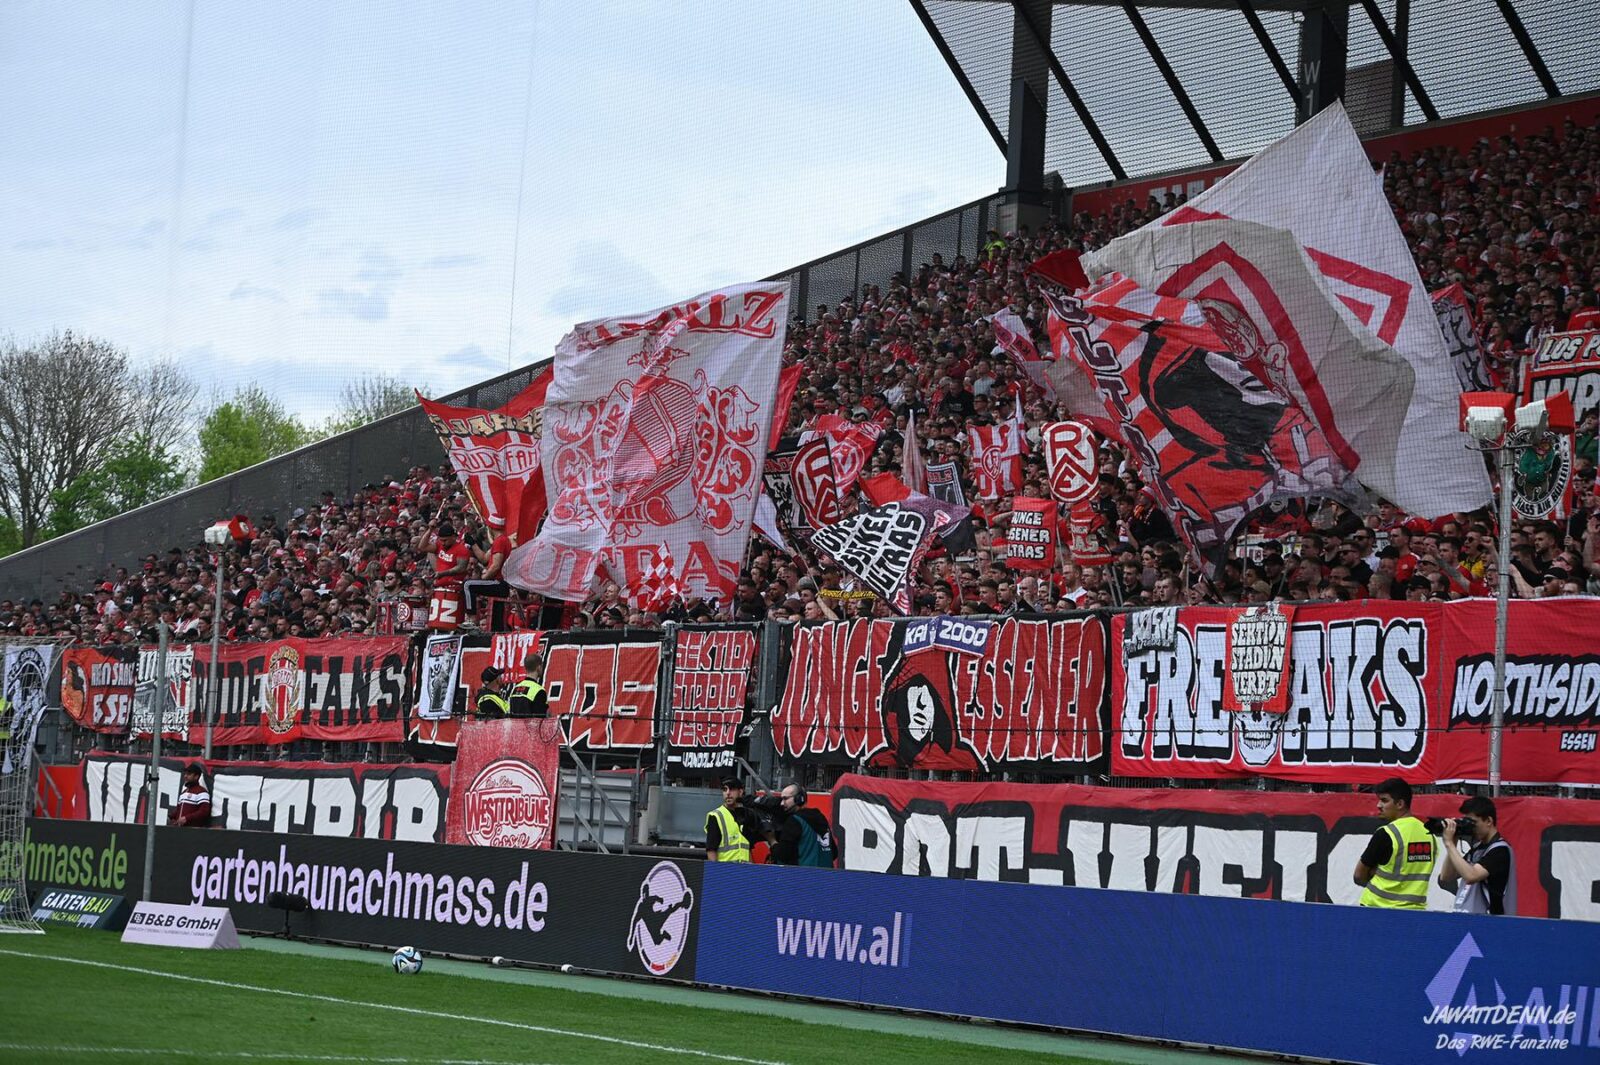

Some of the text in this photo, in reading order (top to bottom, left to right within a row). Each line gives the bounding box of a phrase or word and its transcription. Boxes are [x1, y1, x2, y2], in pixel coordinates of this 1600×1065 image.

[1304, 60, 1320, 85] W
[1306, 89, 1314, 116] 1
[1539, 336, 1583, 362] LOS
[1010, 511, 1043, 526] UNGE
[1007, 543, 1045, 560] LTRAS
[938, 619, 989, 647] 2000
[674, 630, 756, 671] SEKTION
[193, 654, 265, 728] RUDE
[300, 652, 403, 727] FANS
[770, 617, 896, 758] JUNGE
[954, 616, 1105, 763] ESSENER
[1121, 618, 1427, 769] FREAKS
[1450, 660, 1600, 719] NORTHSID
[1560, 732, 1597, 751] ESSEN
[41, 891, 114, 914] GARTENBAU
[145, 913, 222, 931] B&B GmbH
